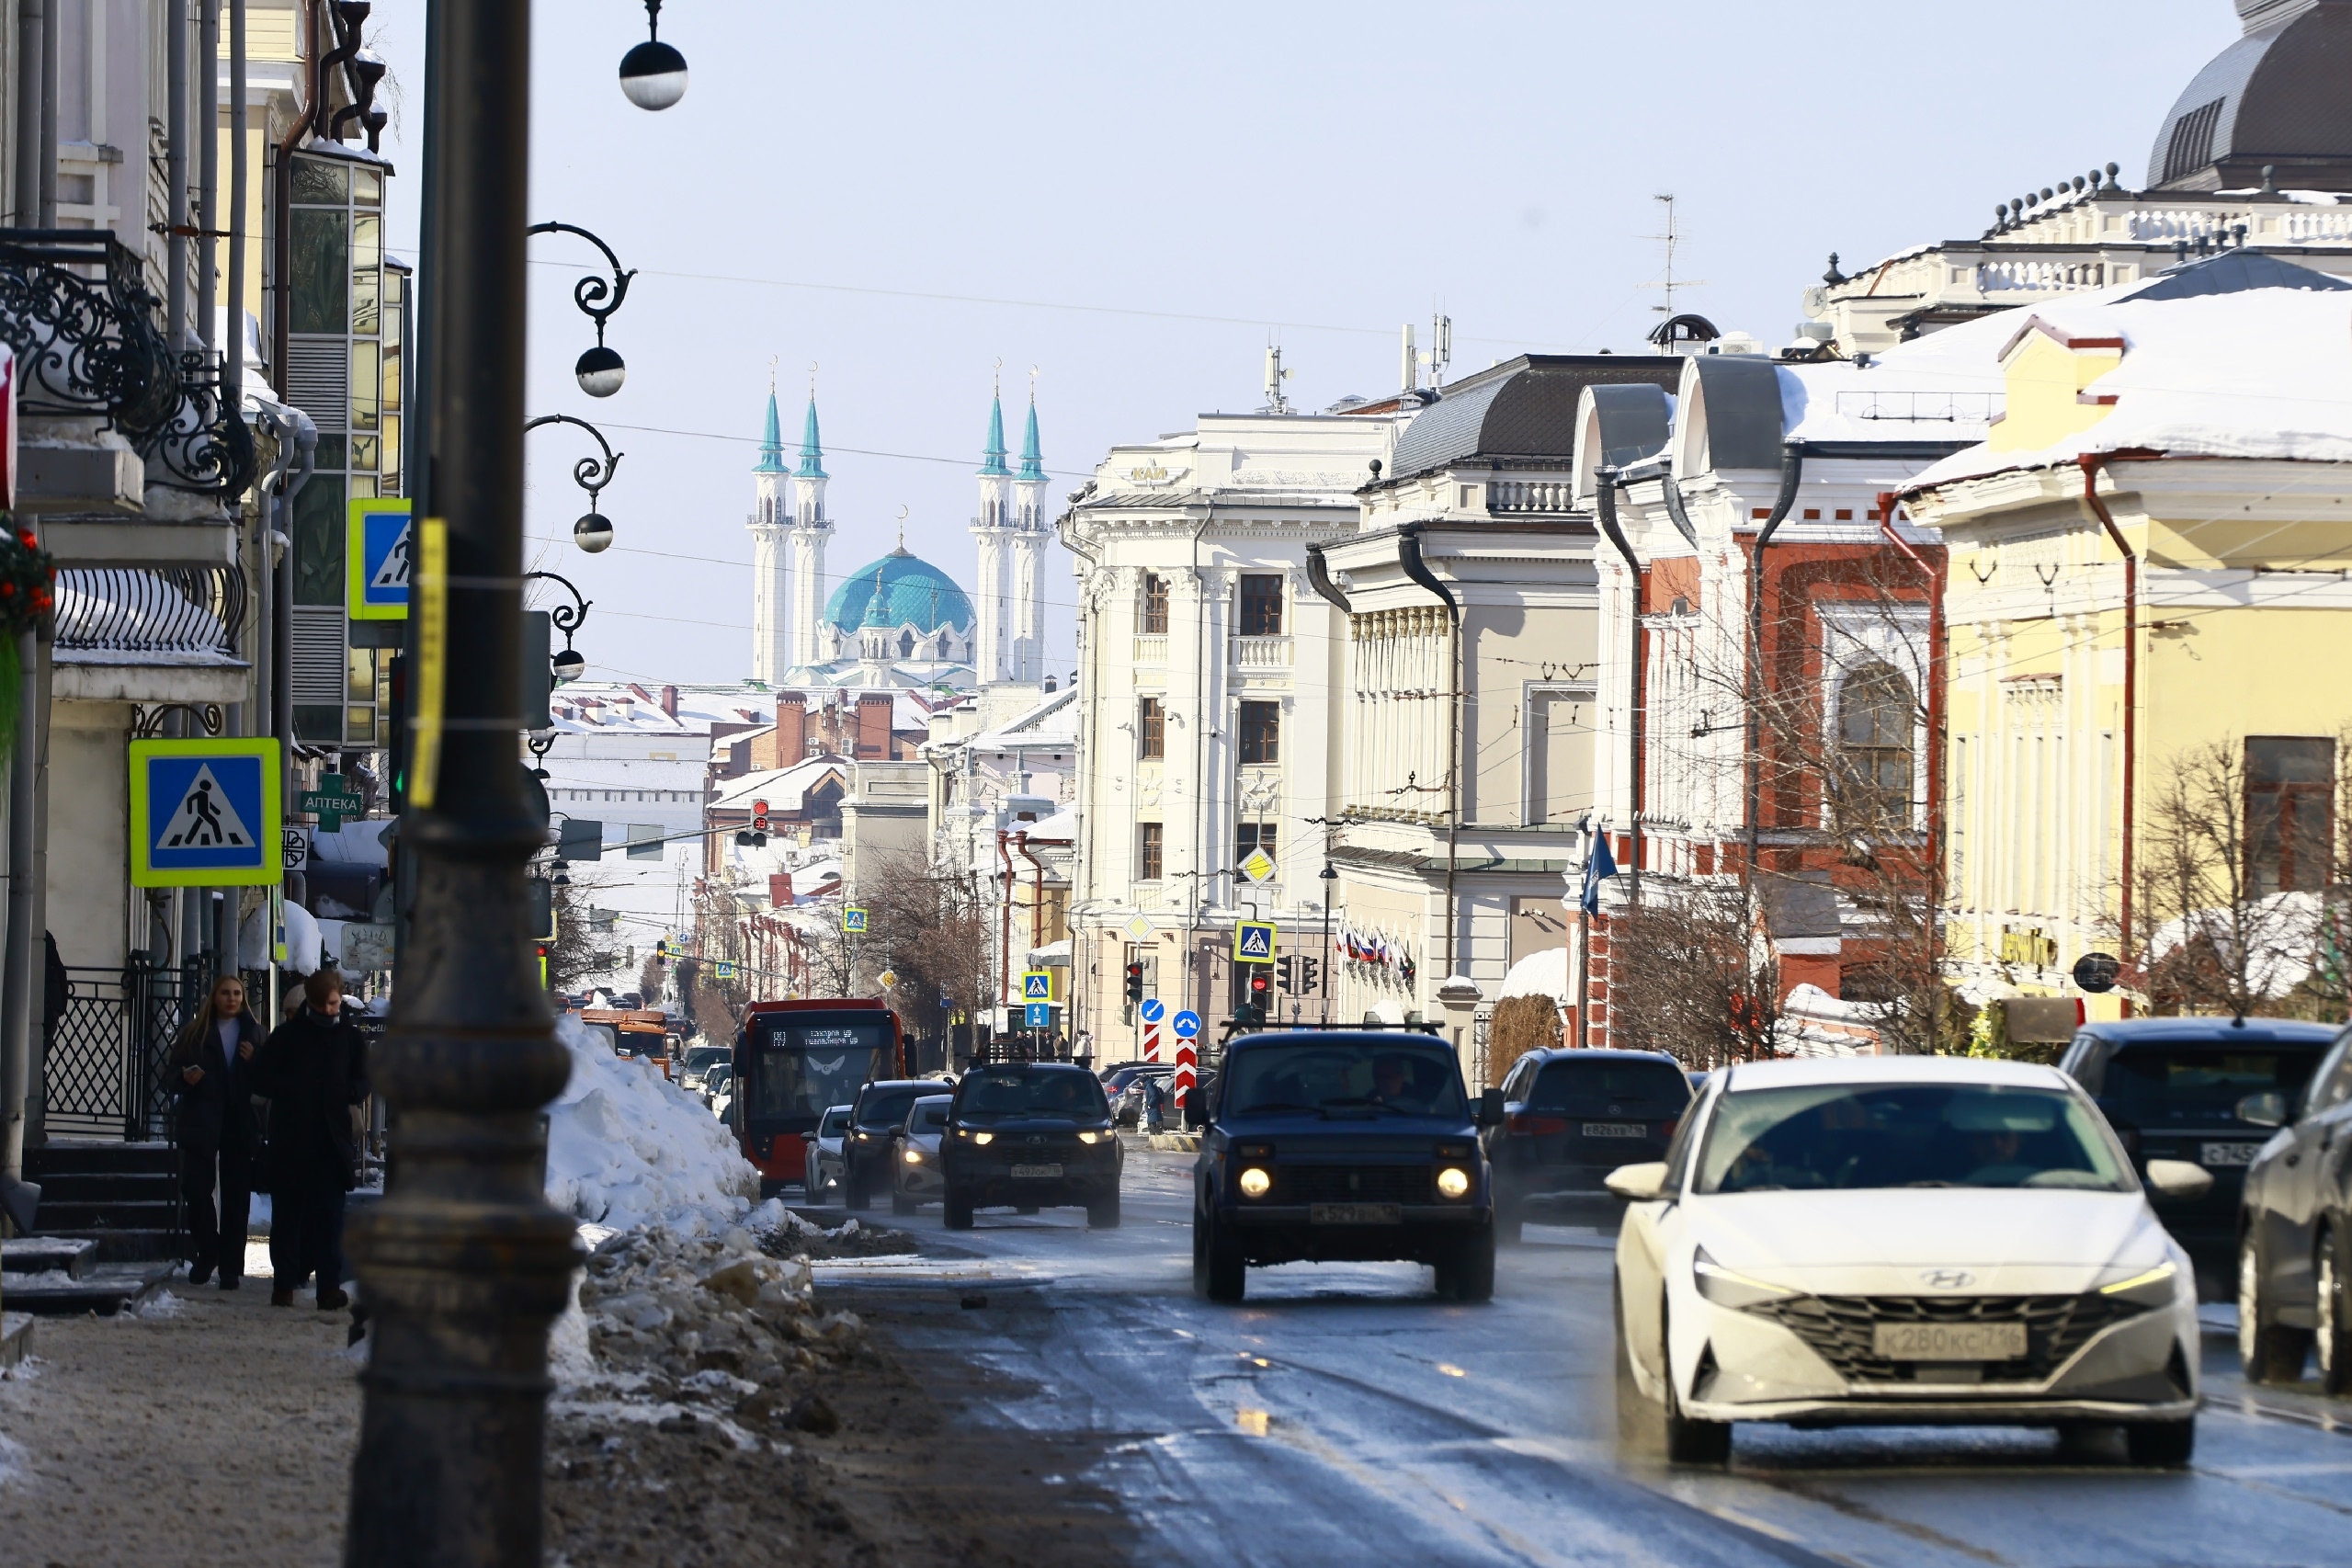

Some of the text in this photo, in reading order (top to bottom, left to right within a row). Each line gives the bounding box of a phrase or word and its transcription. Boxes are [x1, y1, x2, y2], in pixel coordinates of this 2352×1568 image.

[1132, 466, 1166, 480] КАИ
[305, 796, 358, 811] АПТЕКА
[756, 819, 766, 829] 33
